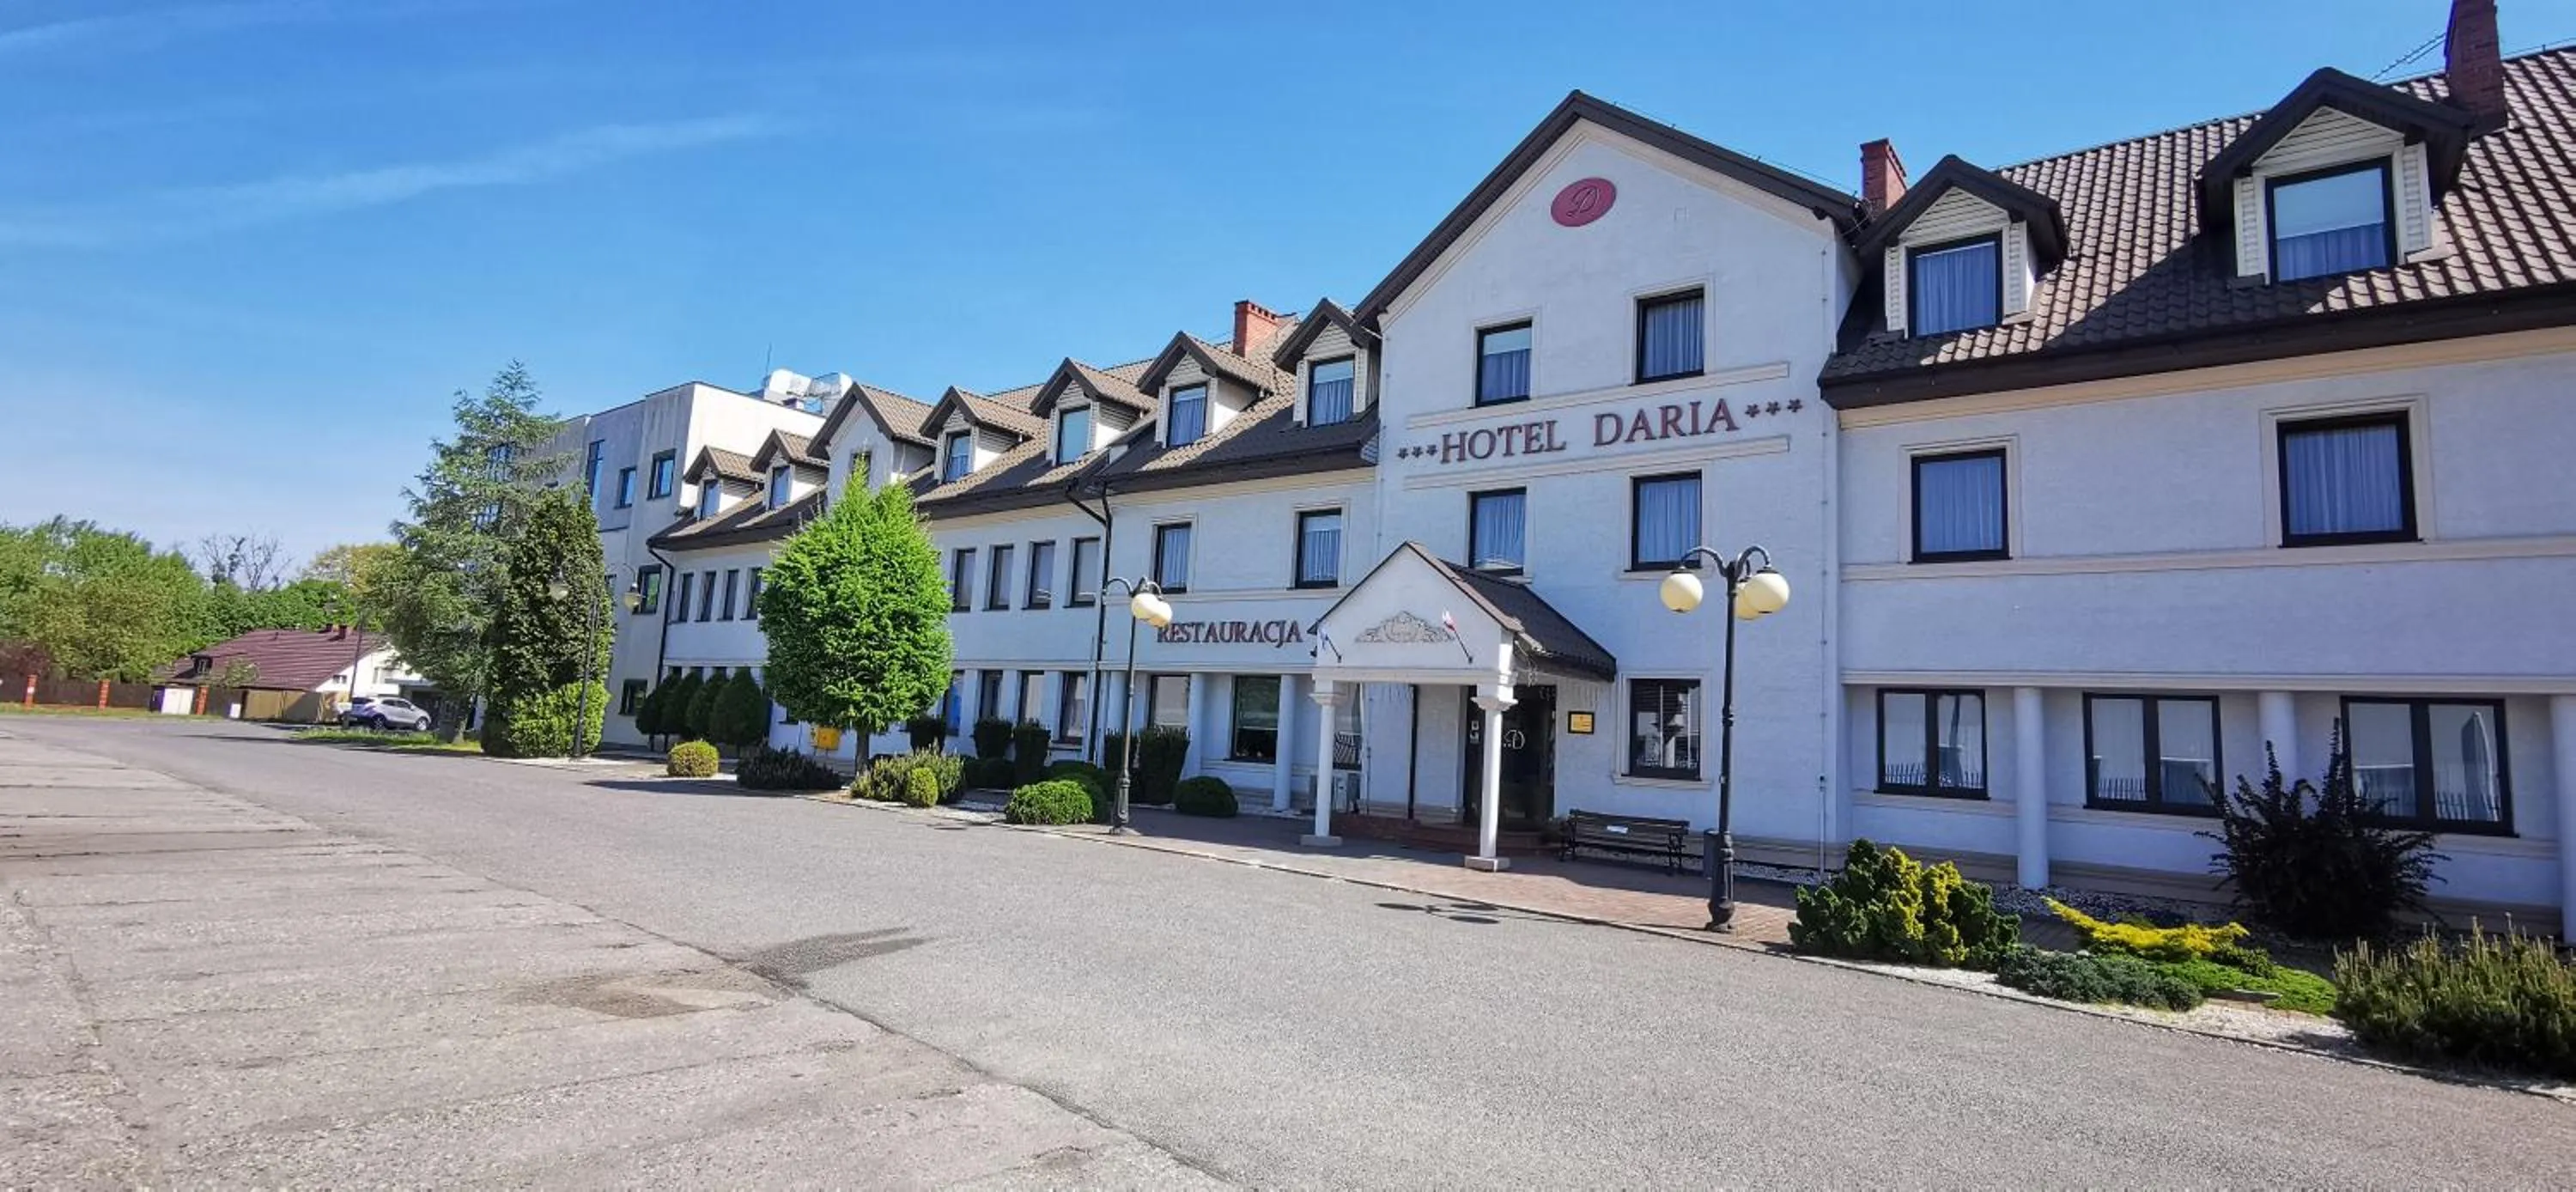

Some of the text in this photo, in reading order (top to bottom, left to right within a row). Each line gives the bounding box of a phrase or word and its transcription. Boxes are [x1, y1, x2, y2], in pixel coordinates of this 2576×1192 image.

[1440, 398, 1741, 465] HOTEL DARIA
[1156, 619, 1303, 648] RESTAURACJA
